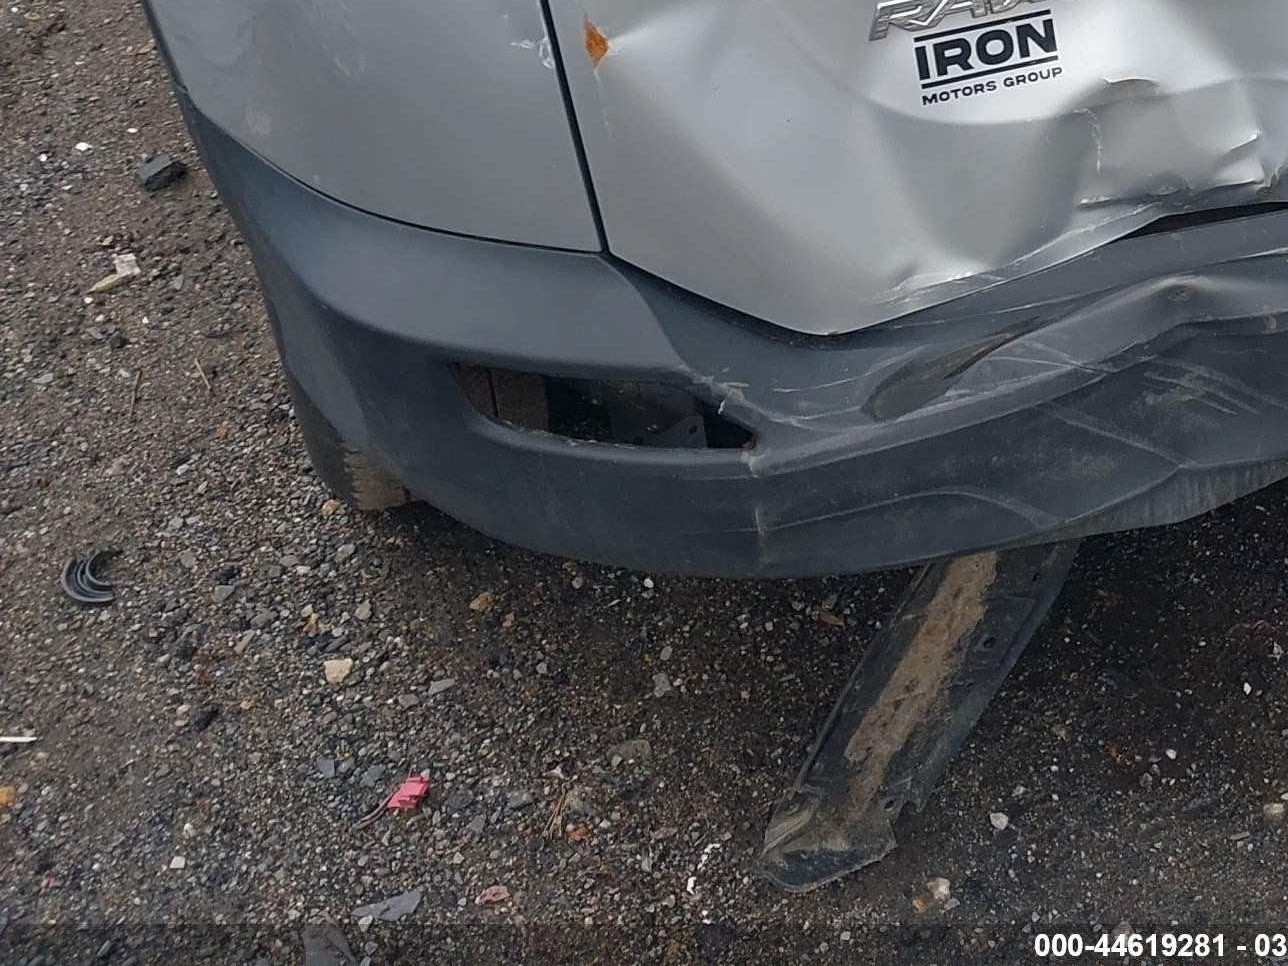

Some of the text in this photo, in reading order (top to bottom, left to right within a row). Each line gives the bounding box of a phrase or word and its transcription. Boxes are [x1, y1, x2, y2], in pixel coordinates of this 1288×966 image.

[915, 18, 1058, 81] IRON
[922, 66, 1064, 106] MOTORS GROUP
